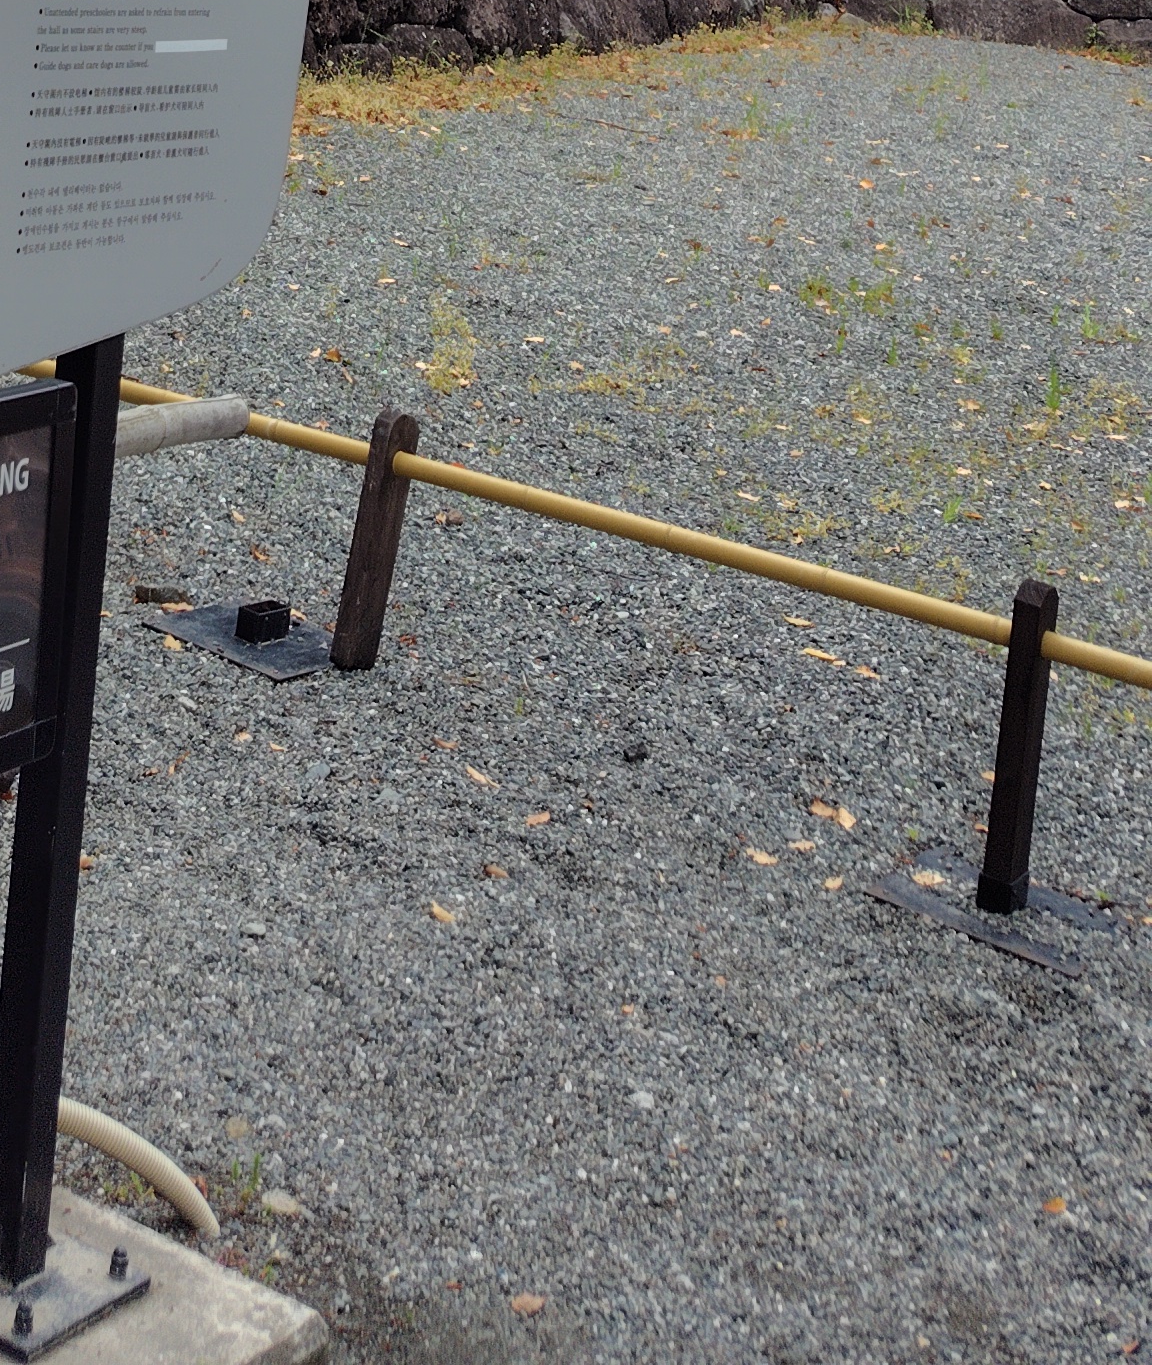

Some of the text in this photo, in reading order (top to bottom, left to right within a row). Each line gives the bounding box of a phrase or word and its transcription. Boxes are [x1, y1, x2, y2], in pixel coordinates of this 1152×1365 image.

[44, 7, 78, 16] Unattended
[80, 8, 116, 18] preschoolers
[129, 8, 145, 16] asked
[153, 8, 172, 16] refrain
[174, 7, 186, 16] from
[188, 9, 210, 17] entering
[117, 27, 130, 35] very
[41, 44, 59, 52] Please
[61, 43, 69, 52] let
[80, 43, 95, 51] know
[104, 43, 113, 51] the
[115, 43, 136, 51] counter
[143, 44, 153, 52] you
[39, 61, 56, 70] Guide
[58, 61, 71, 71] dogs
[73, 61, 84, 69] and
[101, 60, 113, 70] dogs
